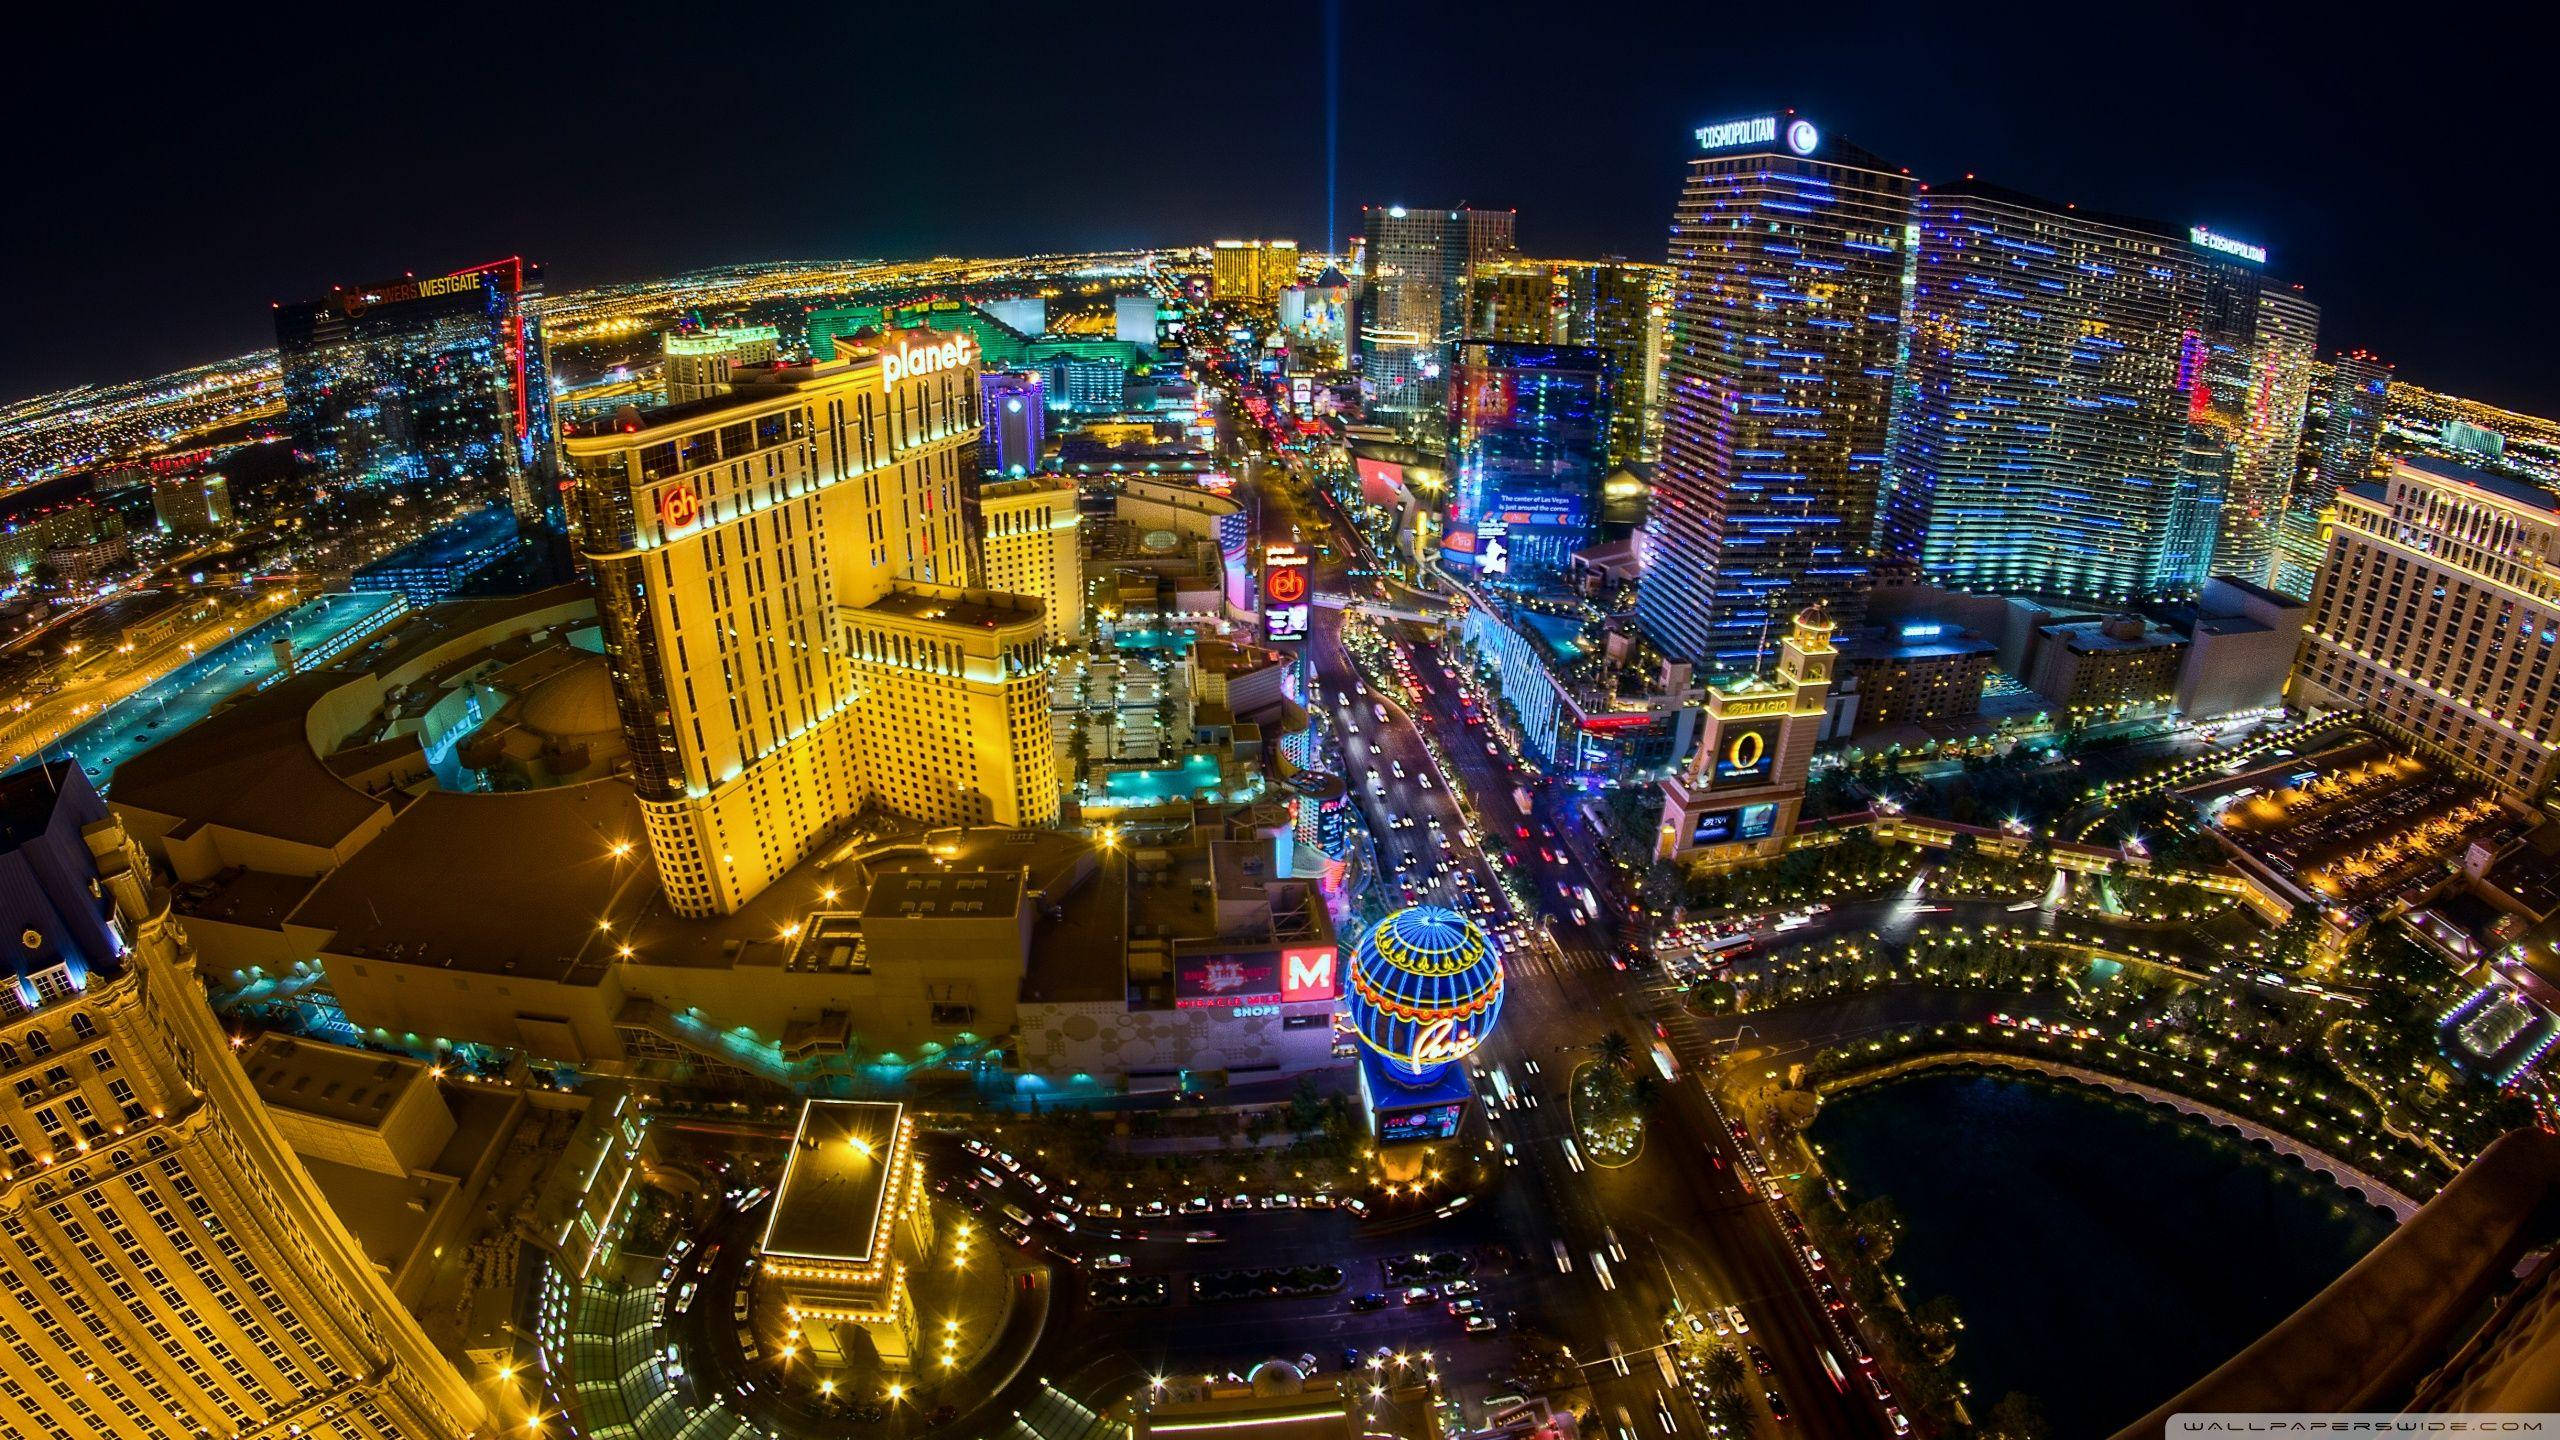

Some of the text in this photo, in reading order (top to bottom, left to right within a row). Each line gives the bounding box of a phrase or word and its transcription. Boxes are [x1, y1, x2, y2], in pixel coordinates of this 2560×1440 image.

[1703, 117, 1776, 149] COSMOPOLITAN
[2190, 227, 2267, 264] THE COSMOPOLITAN
[418, 272, 481, 298] WESTGATE
[932, 301, 960, 311] GRAND
[882, 335, 972, 394] planet
[666, 486, 698, 527] ph
[1505, 504, 1517, 512] just
[1271, 569, 1304, 599] ph
[1728, 700, 1788, 714] BELLAGIO
[1288, 953, 1332, 990] M
[1176, 995, 1243, 1009] MIRACLE
[1232, 1005, 1280, 1018] SHOPS
